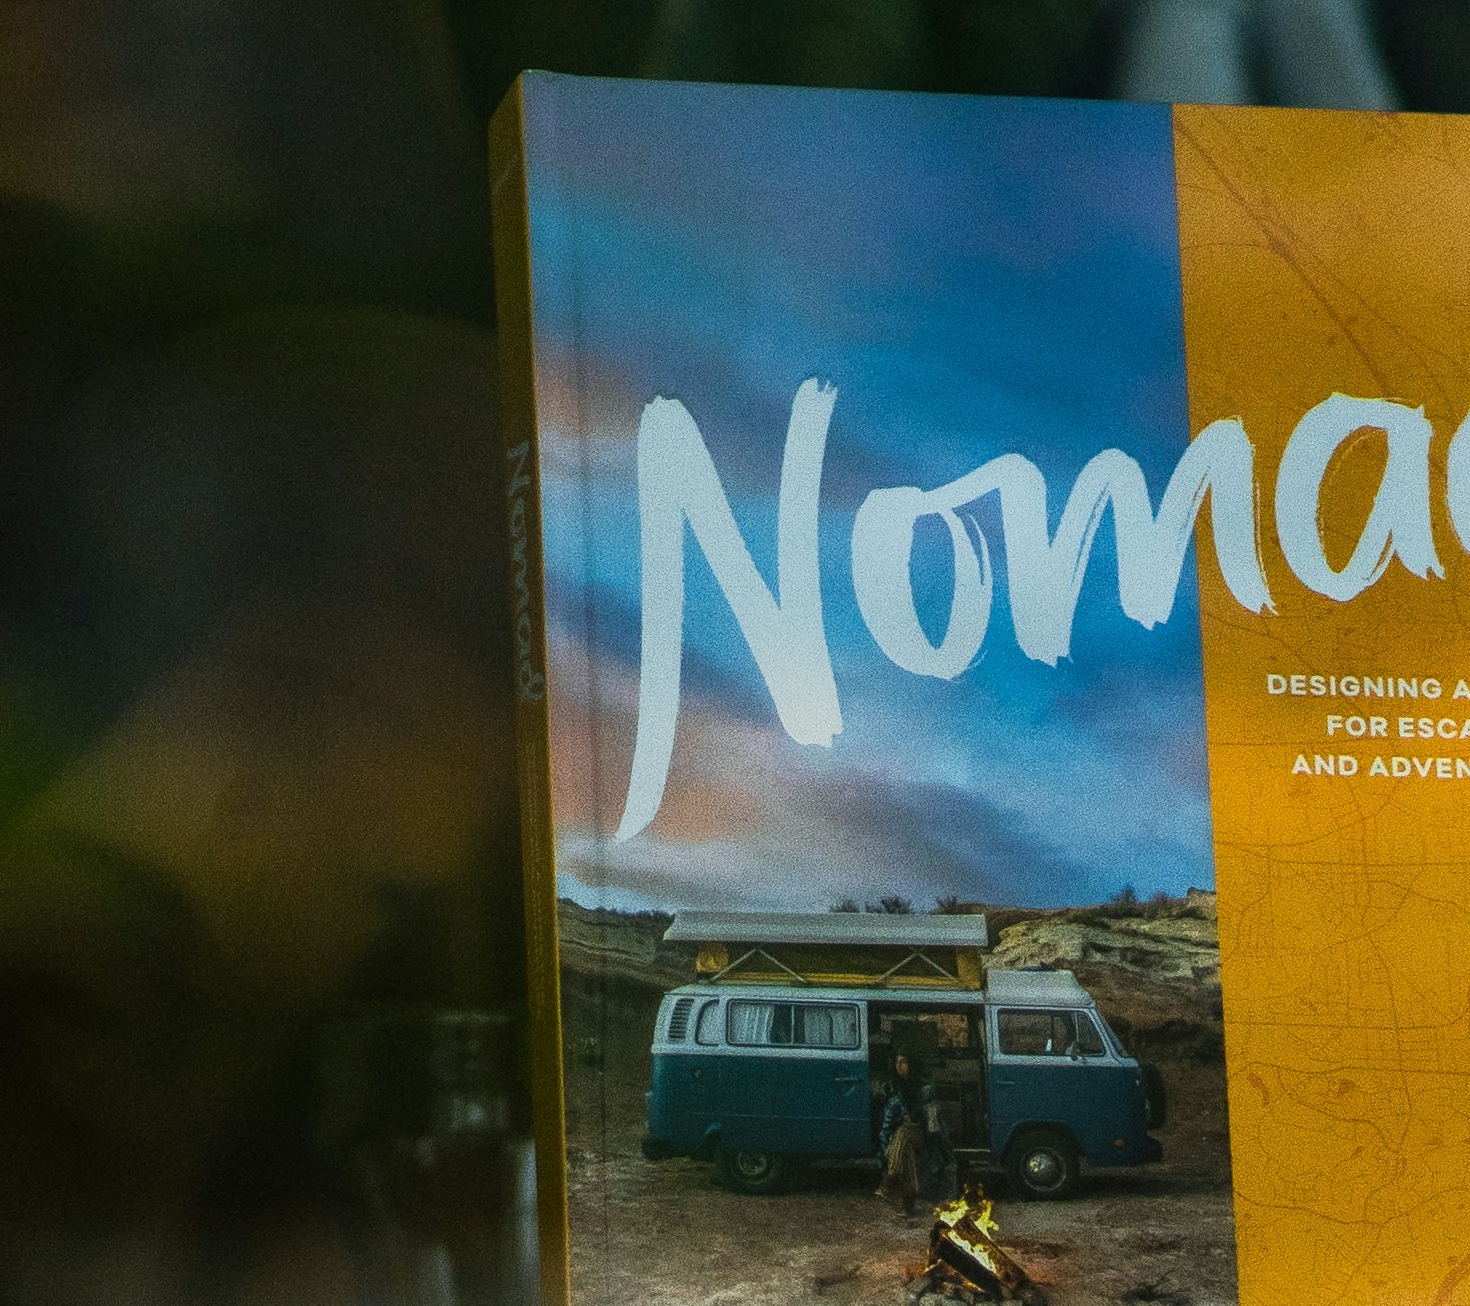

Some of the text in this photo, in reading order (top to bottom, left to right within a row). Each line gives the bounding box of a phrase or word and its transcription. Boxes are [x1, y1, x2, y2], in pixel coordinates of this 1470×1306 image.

[1266, 673, 1442, 699] DESIGNING
[1326, 714, 1388, 738] FOR
[1291, 753, 1358, 777] AND
